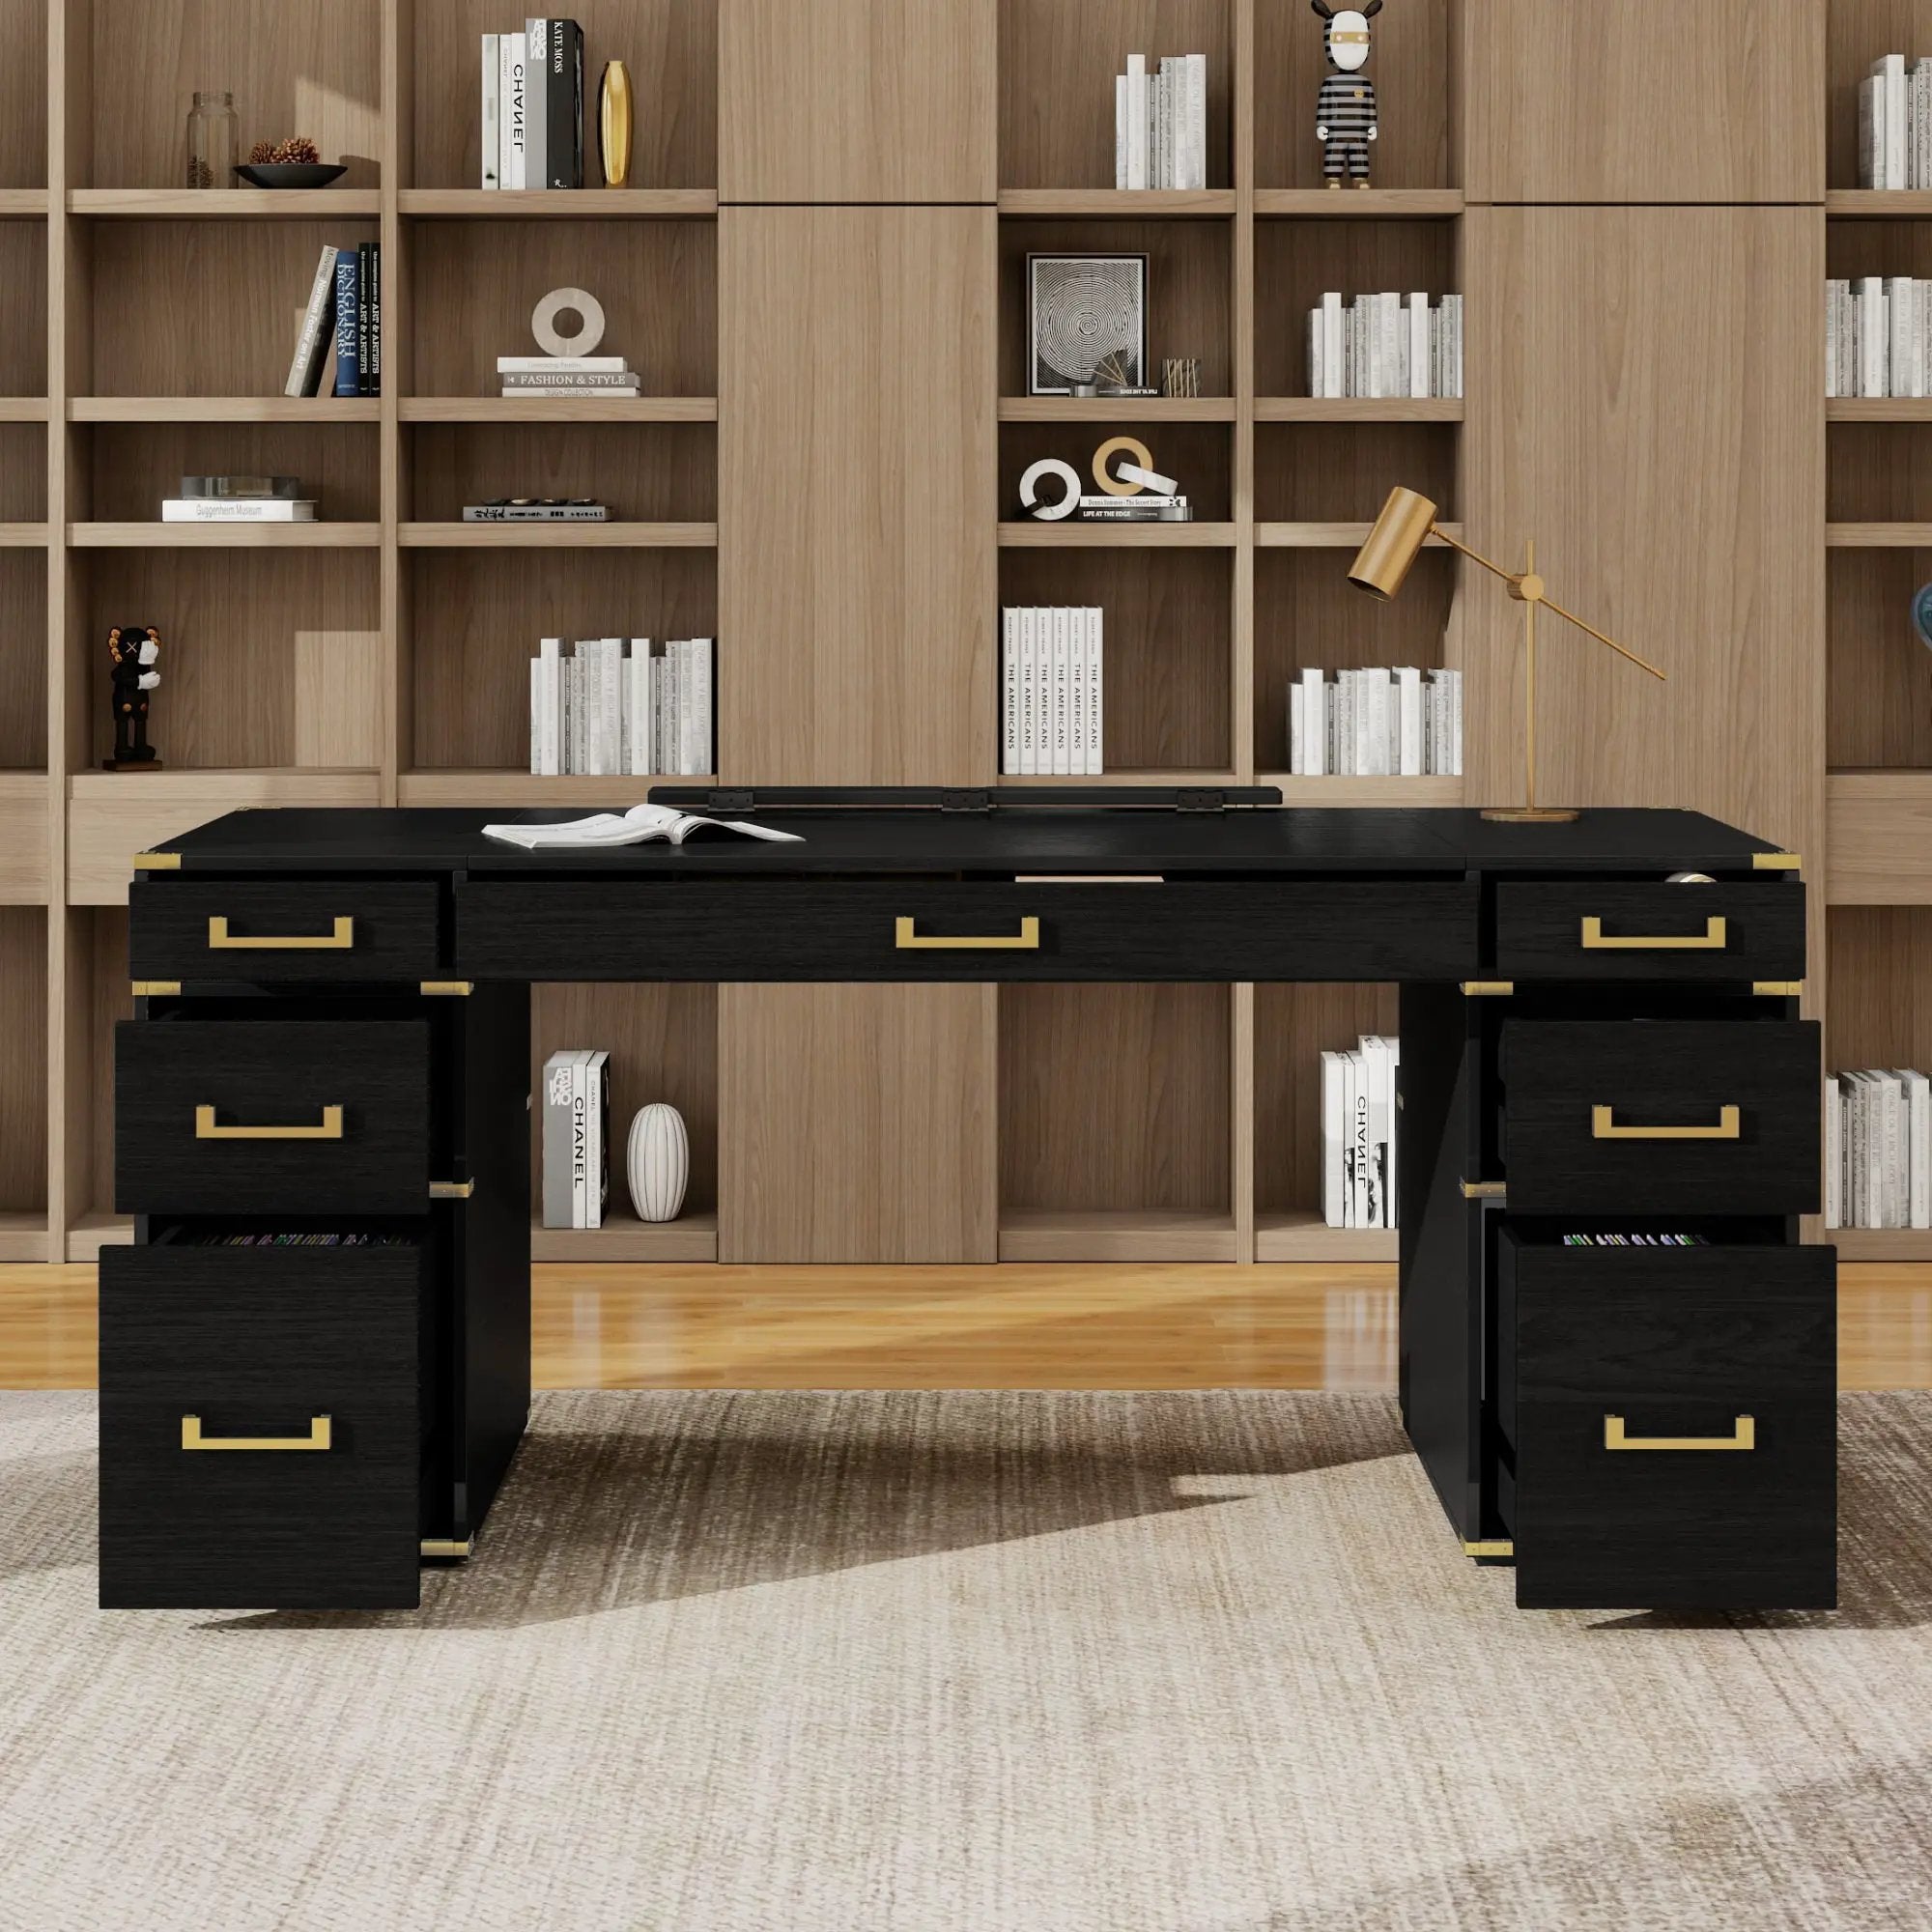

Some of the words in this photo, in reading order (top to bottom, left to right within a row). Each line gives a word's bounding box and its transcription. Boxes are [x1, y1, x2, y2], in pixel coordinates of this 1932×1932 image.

[554, 21, 563, 47] KATE
[554, 48, 563, 73] MOSS
[311, 279, 327, 312] Norman
[344, 264, 355, 356] ENGLISH
[520, 375, 573, 384] FASHION
[576, 375, 586, 384] &
[588, 375, 626, 384] STYLE
[575, 1096, 583, 1189] CHANEL
